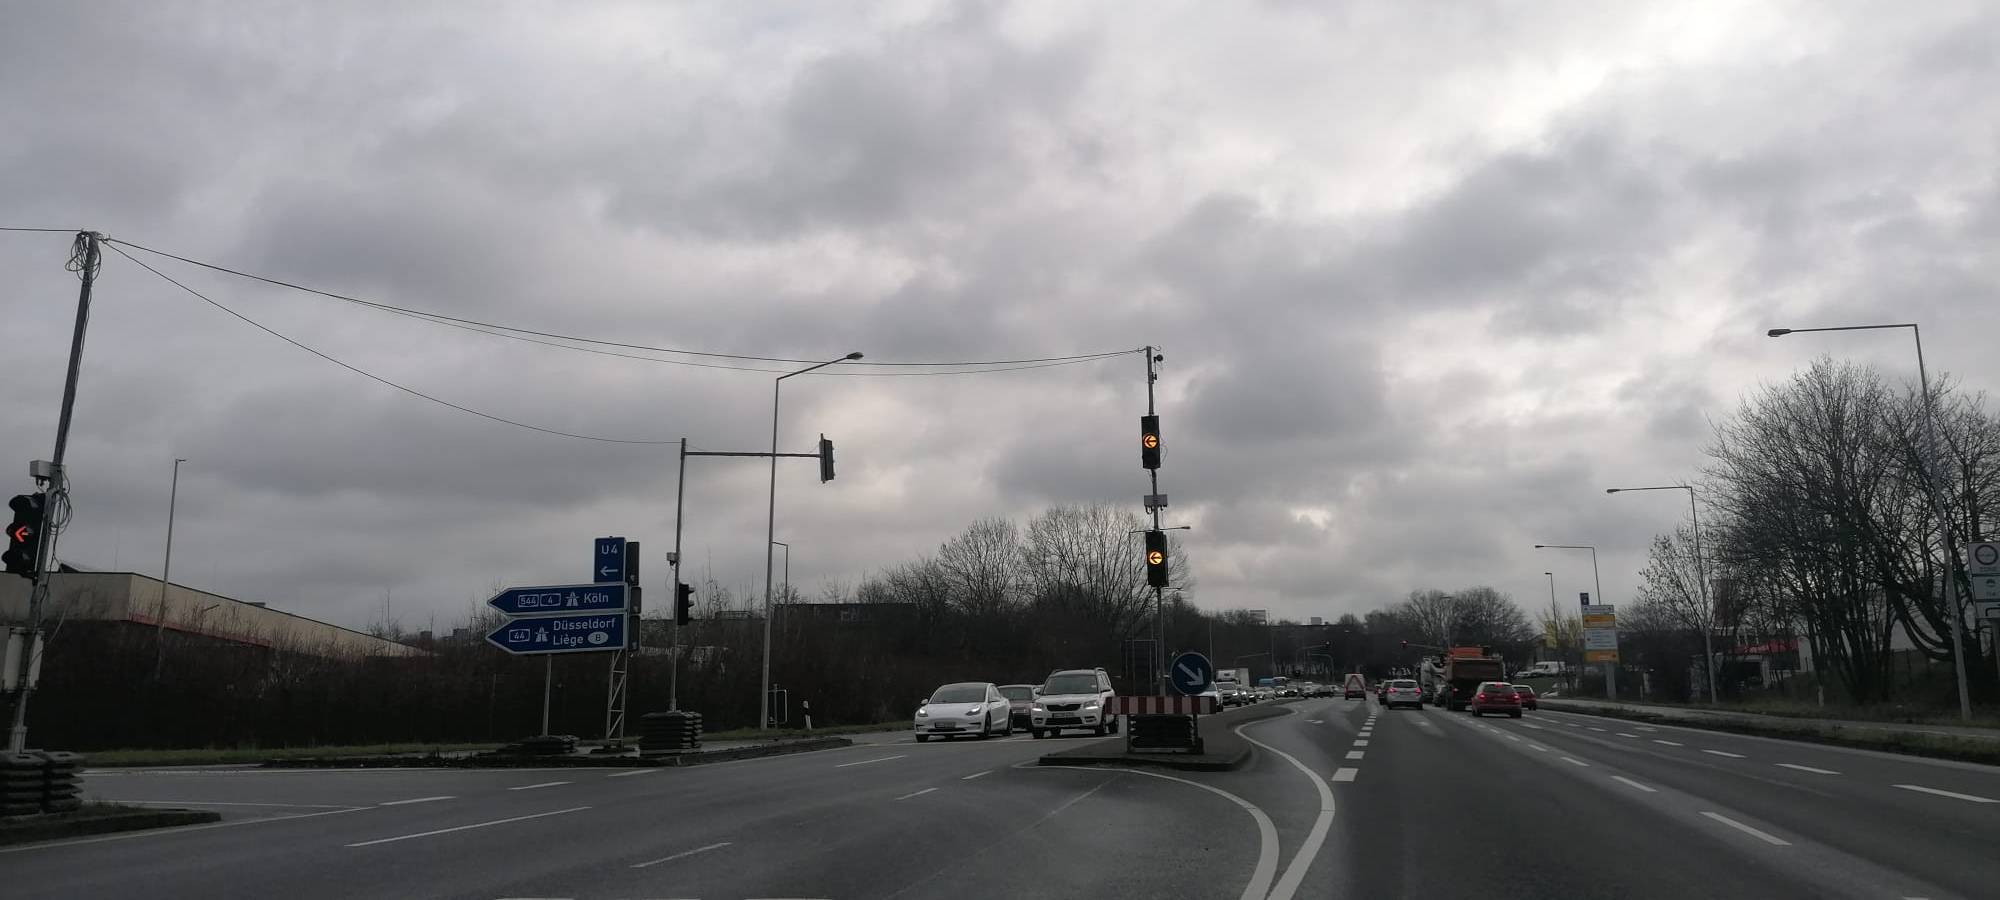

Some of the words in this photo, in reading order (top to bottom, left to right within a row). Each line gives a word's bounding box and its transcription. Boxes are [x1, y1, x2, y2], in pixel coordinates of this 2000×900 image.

[547, 595, 553, 604] 4
[584, 593, 609, 604] Köln
[553, 618, 616, 631] Düsseldorf
[514, 631, 525, 640] 44
[553, 634, 584, 646] Liège
